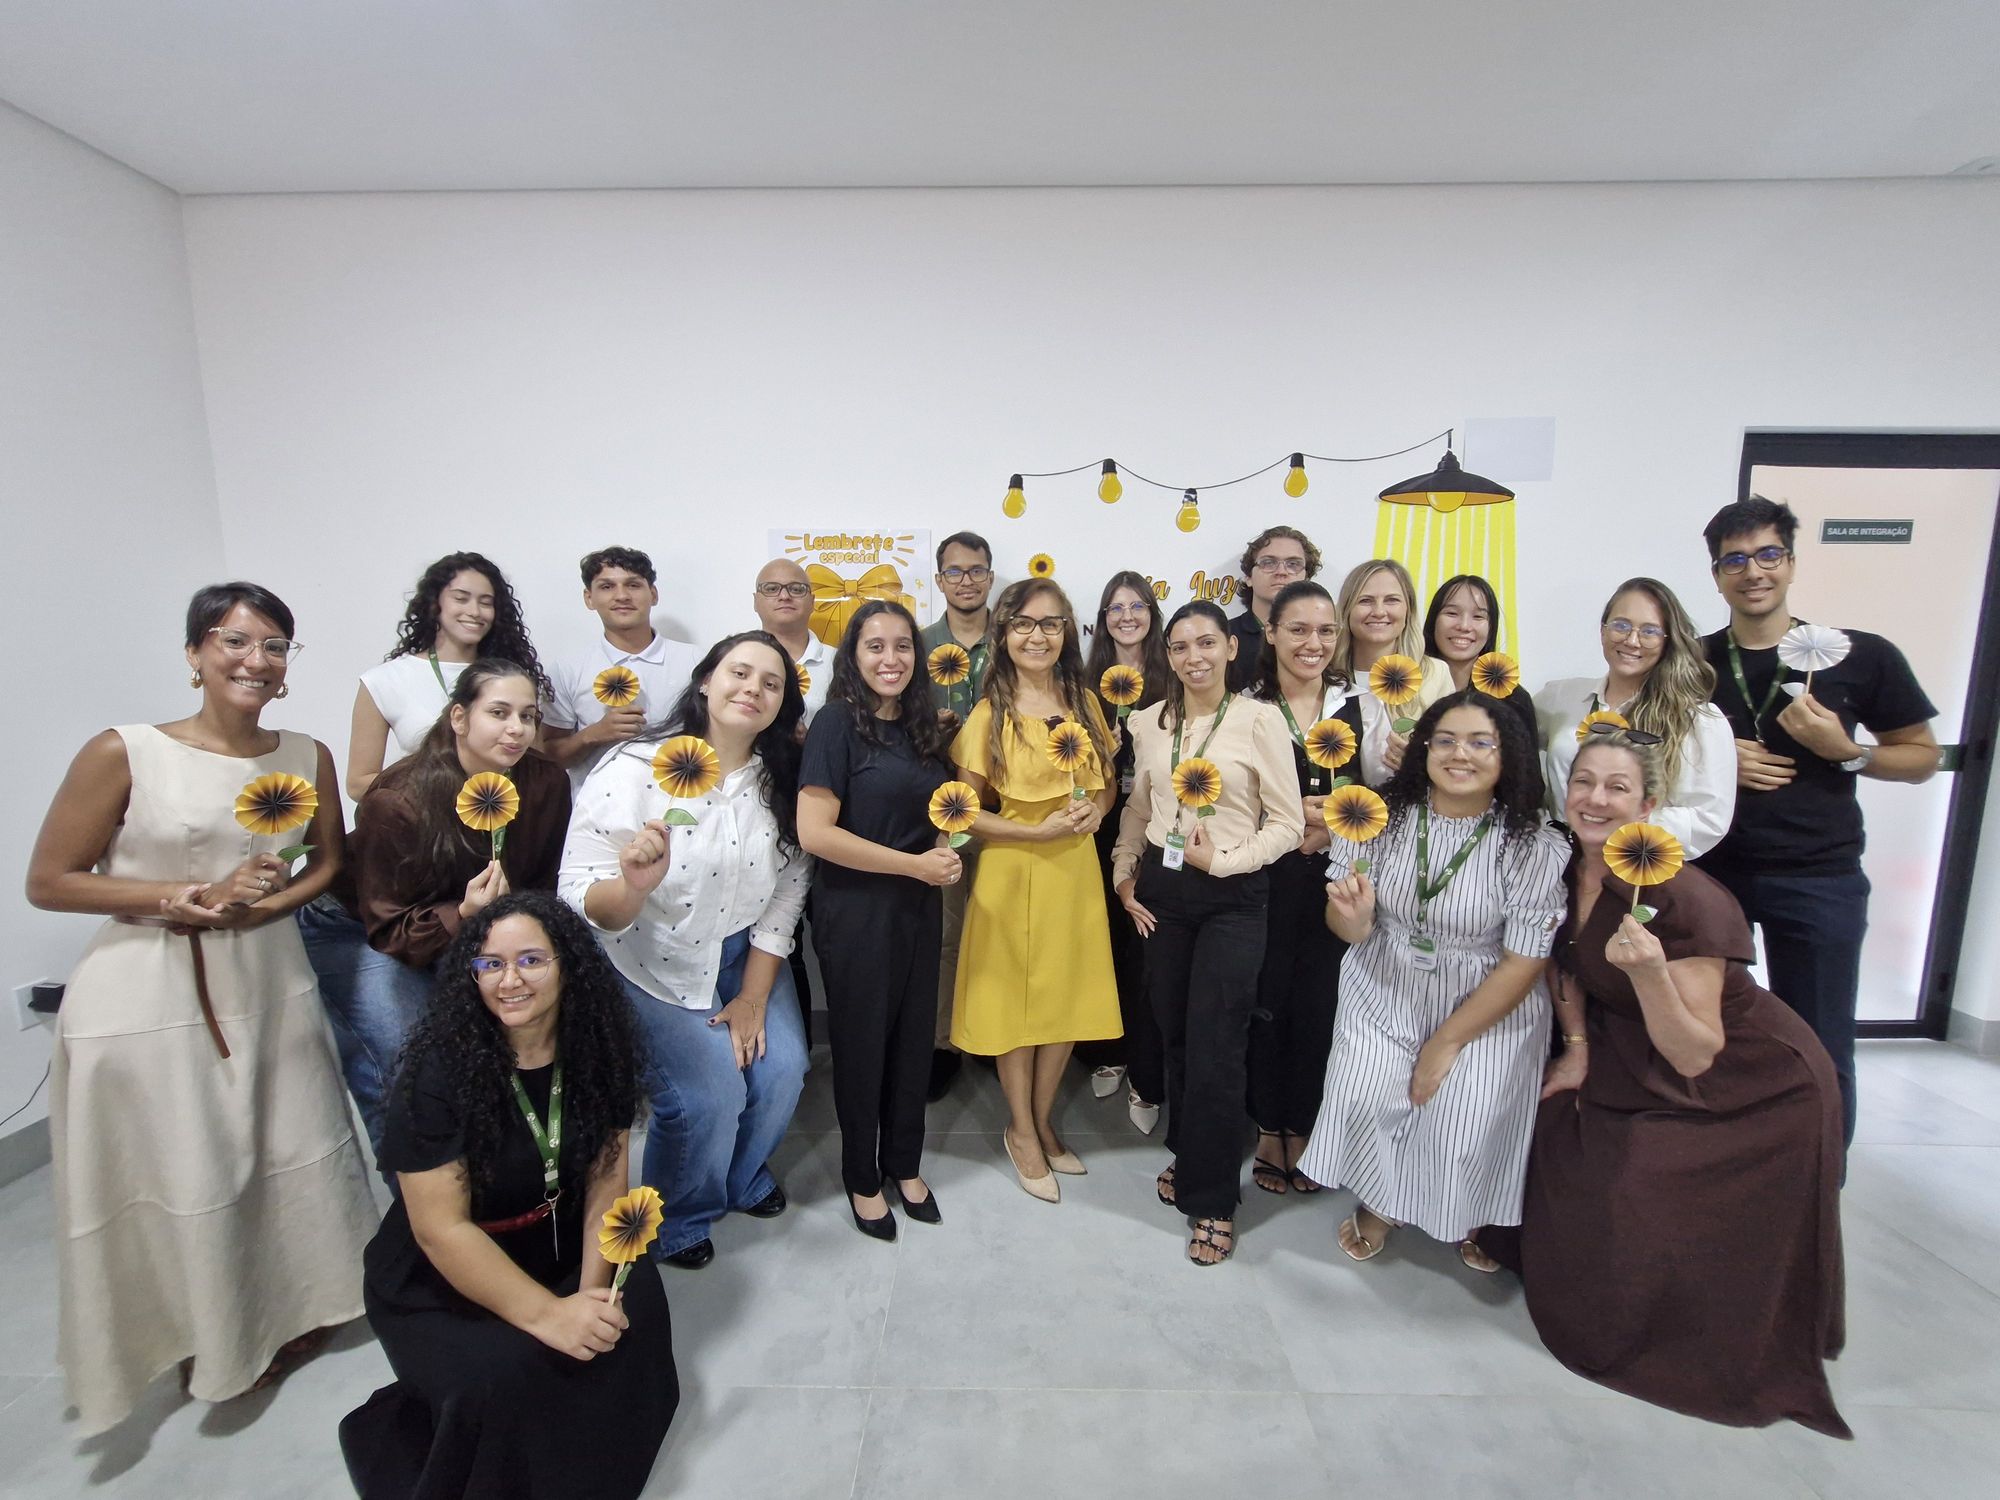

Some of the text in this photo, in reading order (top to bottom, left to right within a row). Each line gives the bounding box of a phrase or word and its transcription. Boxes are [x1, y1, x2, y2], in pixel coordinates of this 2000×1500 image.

[1827, 526, 1908, 537] SALA DE INTEGRAÇÃO
[804, 533, 894, 551] Lembrete
[820, 550, 879, 565] especial
